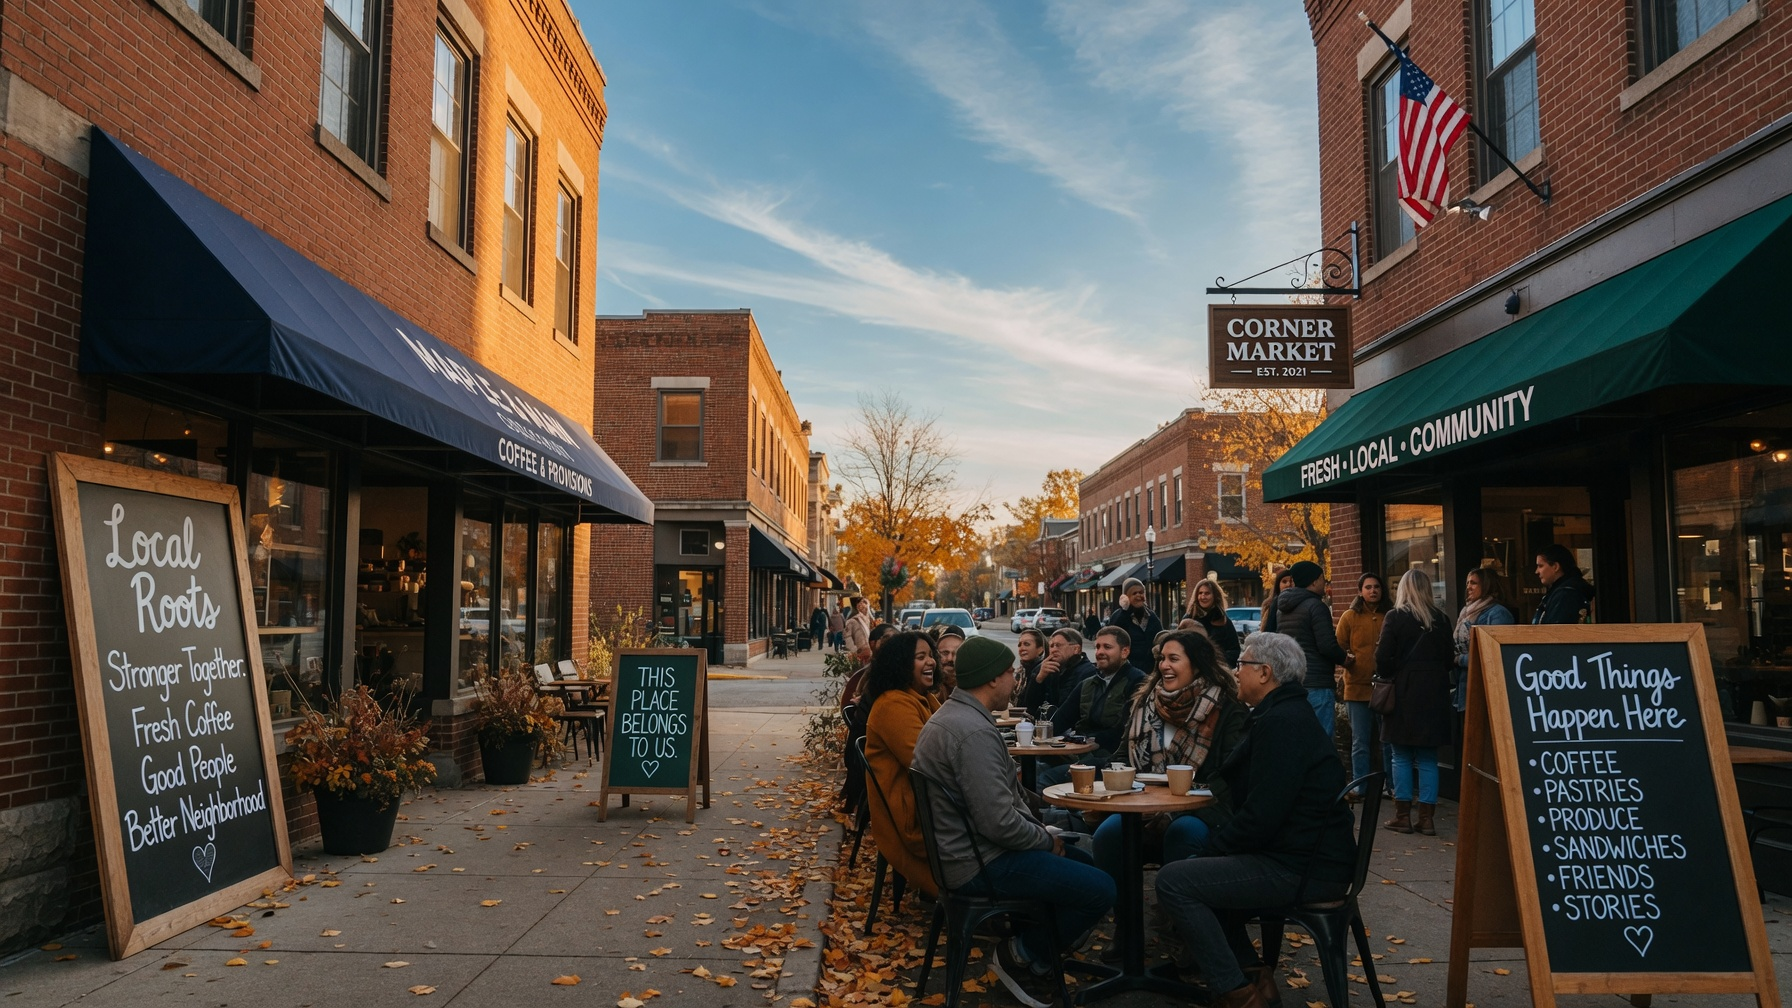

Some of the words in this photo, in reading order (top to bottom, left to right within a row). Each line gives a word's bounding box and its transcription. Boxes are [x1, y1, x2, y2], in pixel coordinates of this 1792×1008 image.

[1227, 318, 1335, 338] CORNER
[1226, 341, 1336, 361] MARKET
[1256, 367, 1279, 377] EST.
[1283, 366, 1307, 377] 2021
[1301, 454, 1340, 489] FRESH
[1350, 436, 1398, 476] LOCAL
[1410, 385, 1535, 456] COMMUNITY
[498, 437, 538, 475] COFFEE
[540, 456, 546, 478] &
[548, 460, 593, 497] PROVISIONS
[104, 503, 202, 570] Local
[130, 571, 221, 634] Roots
[107, 650, 183, 702] Stronger
[181, 646, 246, 697] Together.
[638, 667, 676, 688] THIS
[1515, 653, 1587, 695] Good
[1587, 651, 1682, 706] Things
[631, 690, 680, 711] PLACE
[132, 706, 181, 748] Fresh
[185, 700, 234, 744] Coffee
[621, 713, 688, 735] BELONGS
[1527, 695, 1619, 741] Happen
[1622, 693, 1686, 731] Here
[629, 737, 649, 758] TO
[655, 737, 678, 759] US.
[141, 755, 187, 796] Good
[191, 744, 237, 790] People
[1540, 751, 1622, 775] COFFEE
[1544, 778, 1644, 803] PASTRIES
[124, 807, 177, 853] Better
[180, 779, 267, 841] Neighborhood
[1549, 807, 1644, 831] PRODUCE
[1553, 834, 1687, 860] SANDWICHES
[1558, 864, 1655, 890] FRIENDS
[1564, 893, 1661, 921] STORIES
